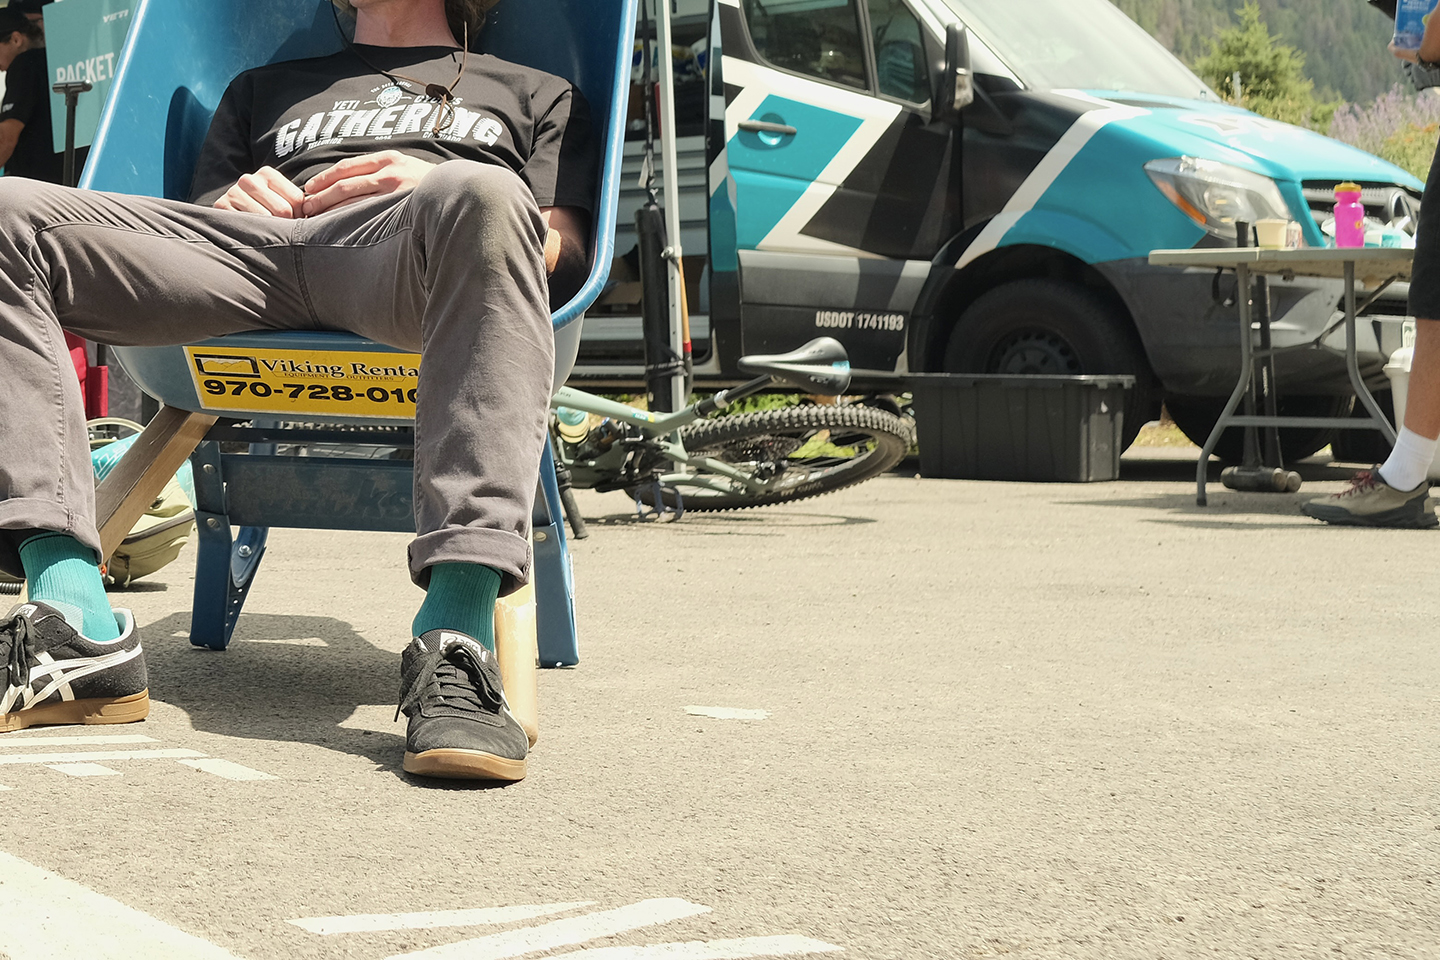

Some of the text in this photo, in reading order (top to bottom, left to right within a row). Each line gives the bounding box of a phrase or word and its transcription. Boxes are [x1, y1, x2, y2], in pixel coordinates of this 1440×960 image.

[103, 9, 129, 23] YETI
[56, 52, 115, 83] PACKET
[332, 100, 361, 111] YETI
[274, 103, 503, 158] GATHERING
[815, 311, 905, 331] USDOT 1741193
[260, 358, 419, 378] Viking Renta
[203, 379, 418, 404] 970-728-01
